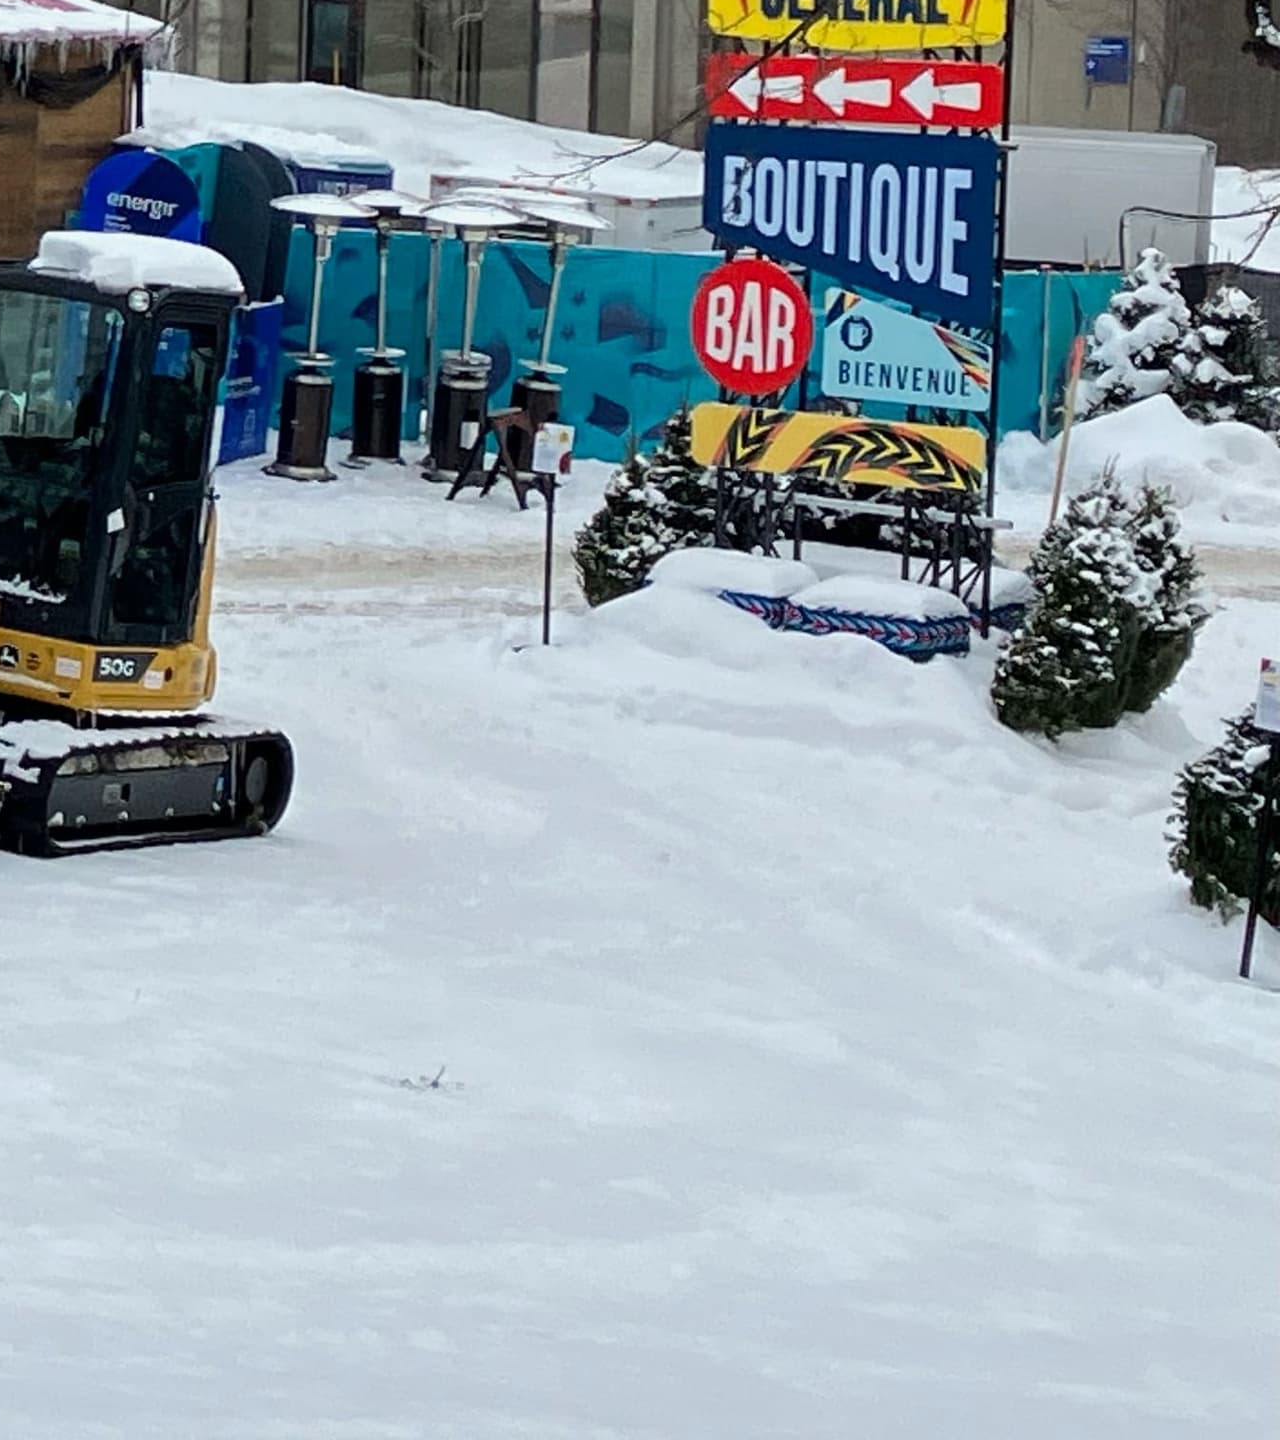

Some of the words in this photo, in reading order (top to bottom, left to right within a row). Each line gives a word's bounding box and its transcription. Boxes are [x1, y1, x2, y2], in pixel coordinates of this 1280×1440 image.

[722, 155, 973, 297] BOUTIQUE
[705, 281, 797, 374] BAR
[838, 359, 972, 398] BIENVENUE
